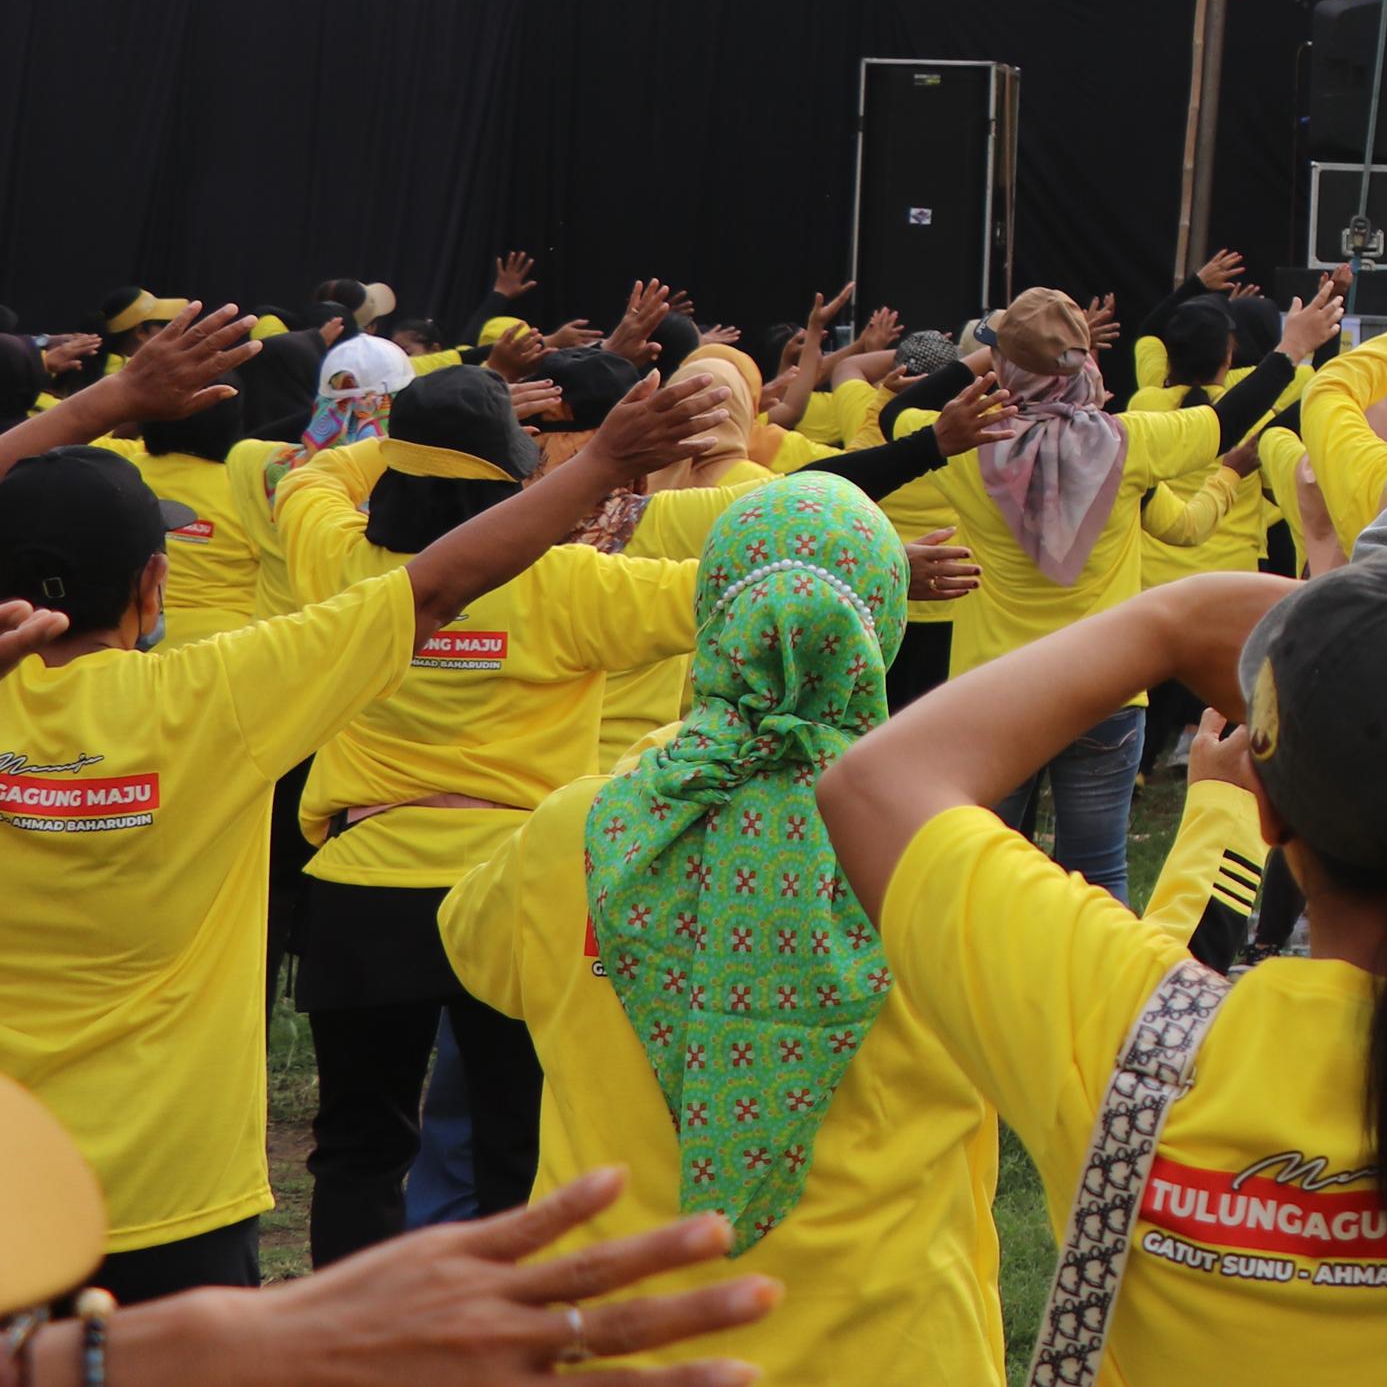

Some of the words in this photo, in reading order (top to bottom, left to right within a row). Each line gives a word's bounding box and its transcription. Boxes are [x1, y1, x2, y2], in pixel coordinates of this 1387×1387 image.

[455, 638, 503, 652] MAJU
[440, 660, 501, 670] BAHARUDIN
[86, 783, 152, 807] MAJU
[12, 816, 65, 832] AHMAD
[65, 813, 153, 832] BAHARUDIN
[1142, 1231, 1219, 1272] GATUT
[1220, 1254, 1296, 1282] SUNU
